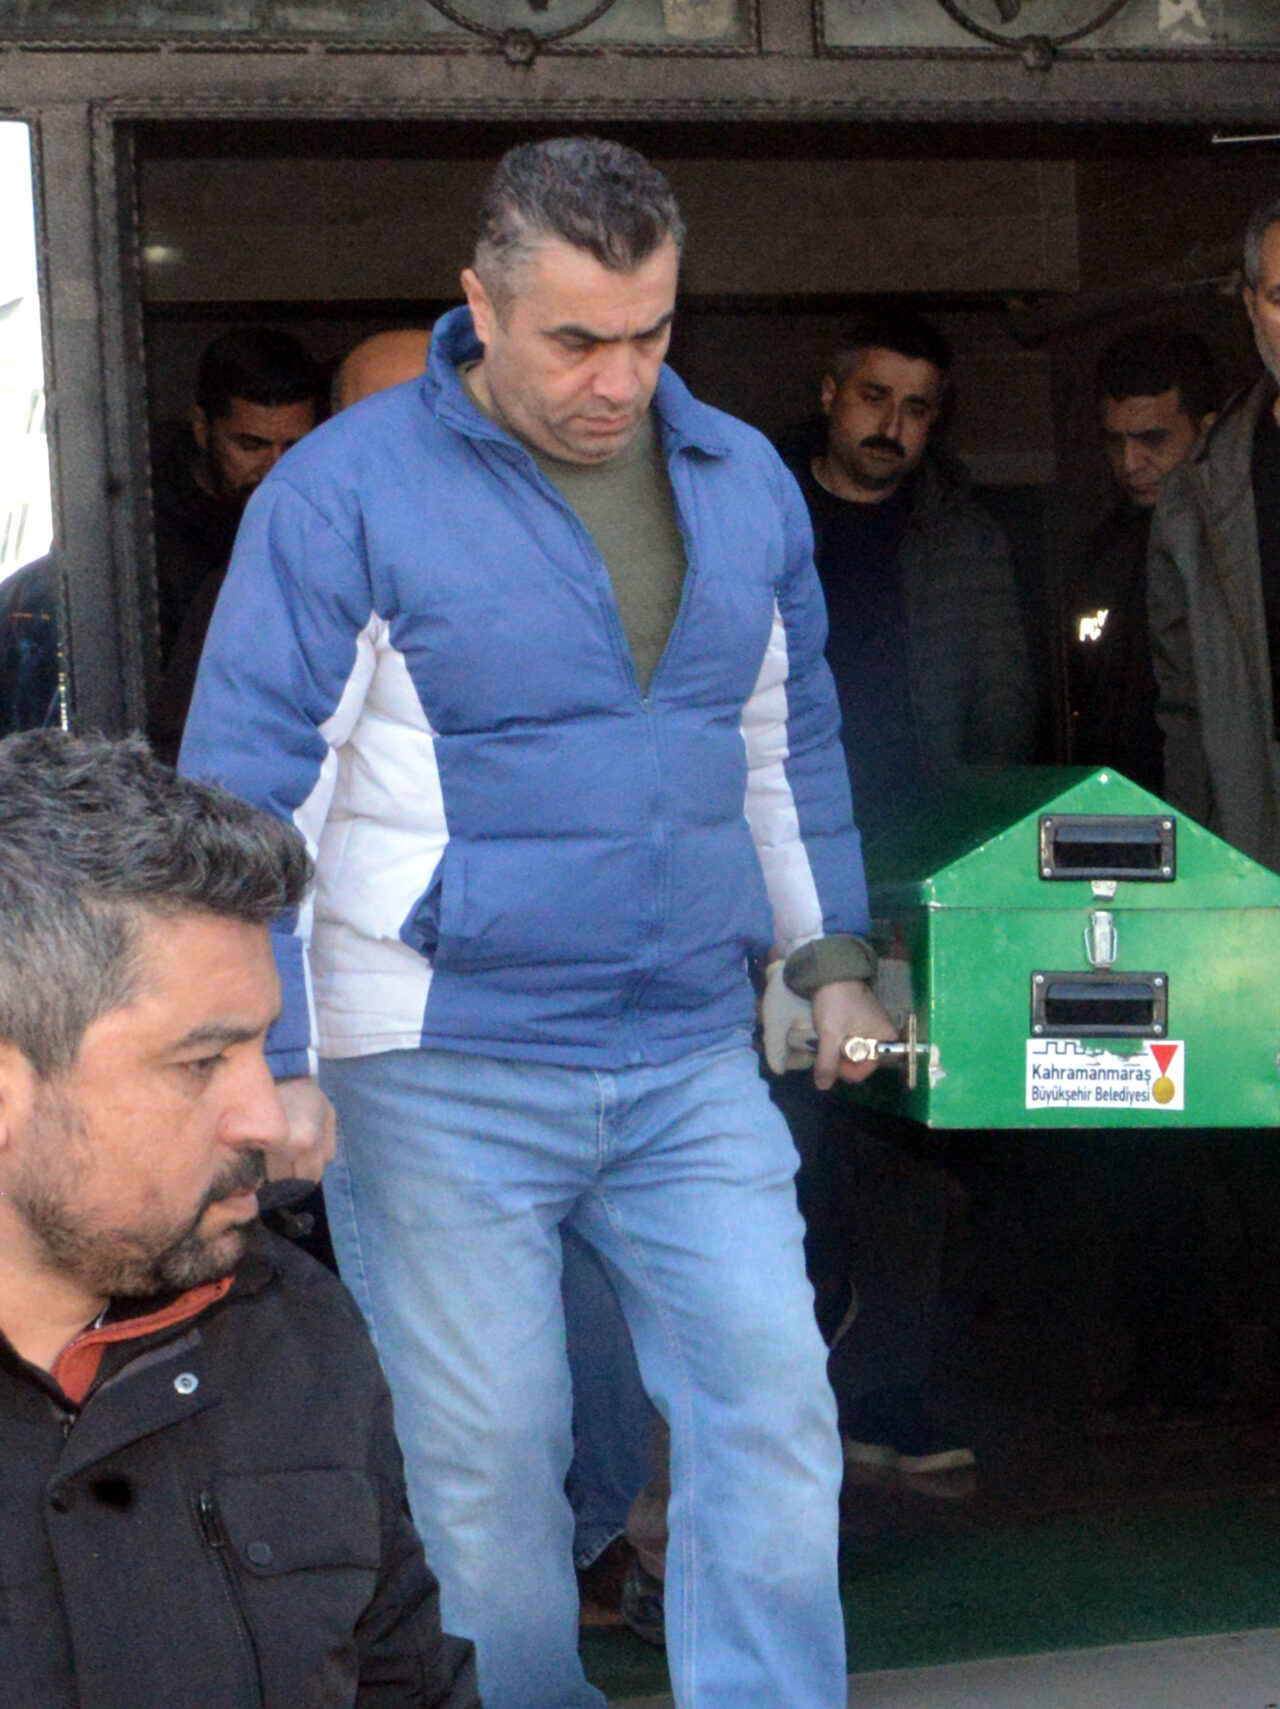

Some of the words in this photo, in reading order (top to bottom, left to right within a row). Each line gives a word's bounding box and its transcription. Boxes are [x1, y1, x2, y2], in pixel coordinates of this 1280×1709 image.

[1032, 1064, 1151, 1083] Kahramanmaraş
[1032, 1085, 1091, 1105] Büyükşehir
[1095, 1086, 1150, 1107] Belediyesi
